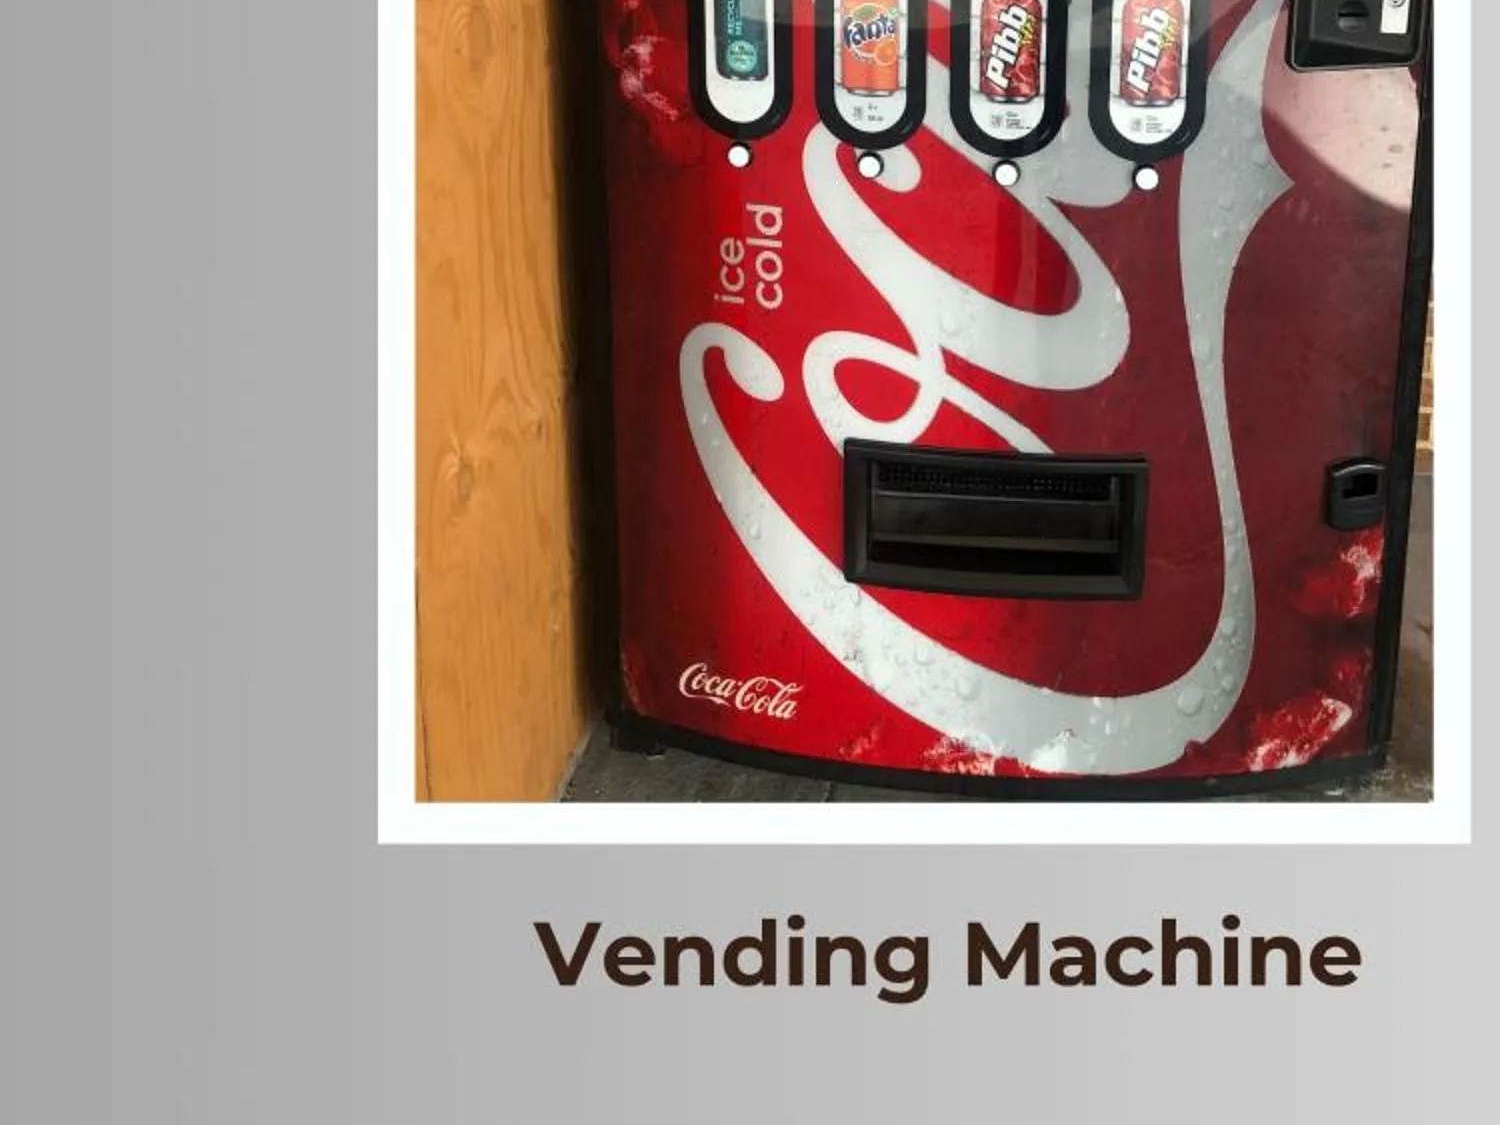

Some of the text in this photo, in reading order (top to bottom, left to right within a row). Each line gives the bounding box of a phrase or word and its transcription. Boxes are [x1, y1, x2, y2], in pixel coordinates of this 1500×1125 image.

[986, 4, 1028, 90] Pibb
[1127, 7, 1169, 93] Pibb
[713, 236, 746, 305] ice
[745, 202, 784, 311] cold
[679, 662, 804, 720] Coca-Cola
